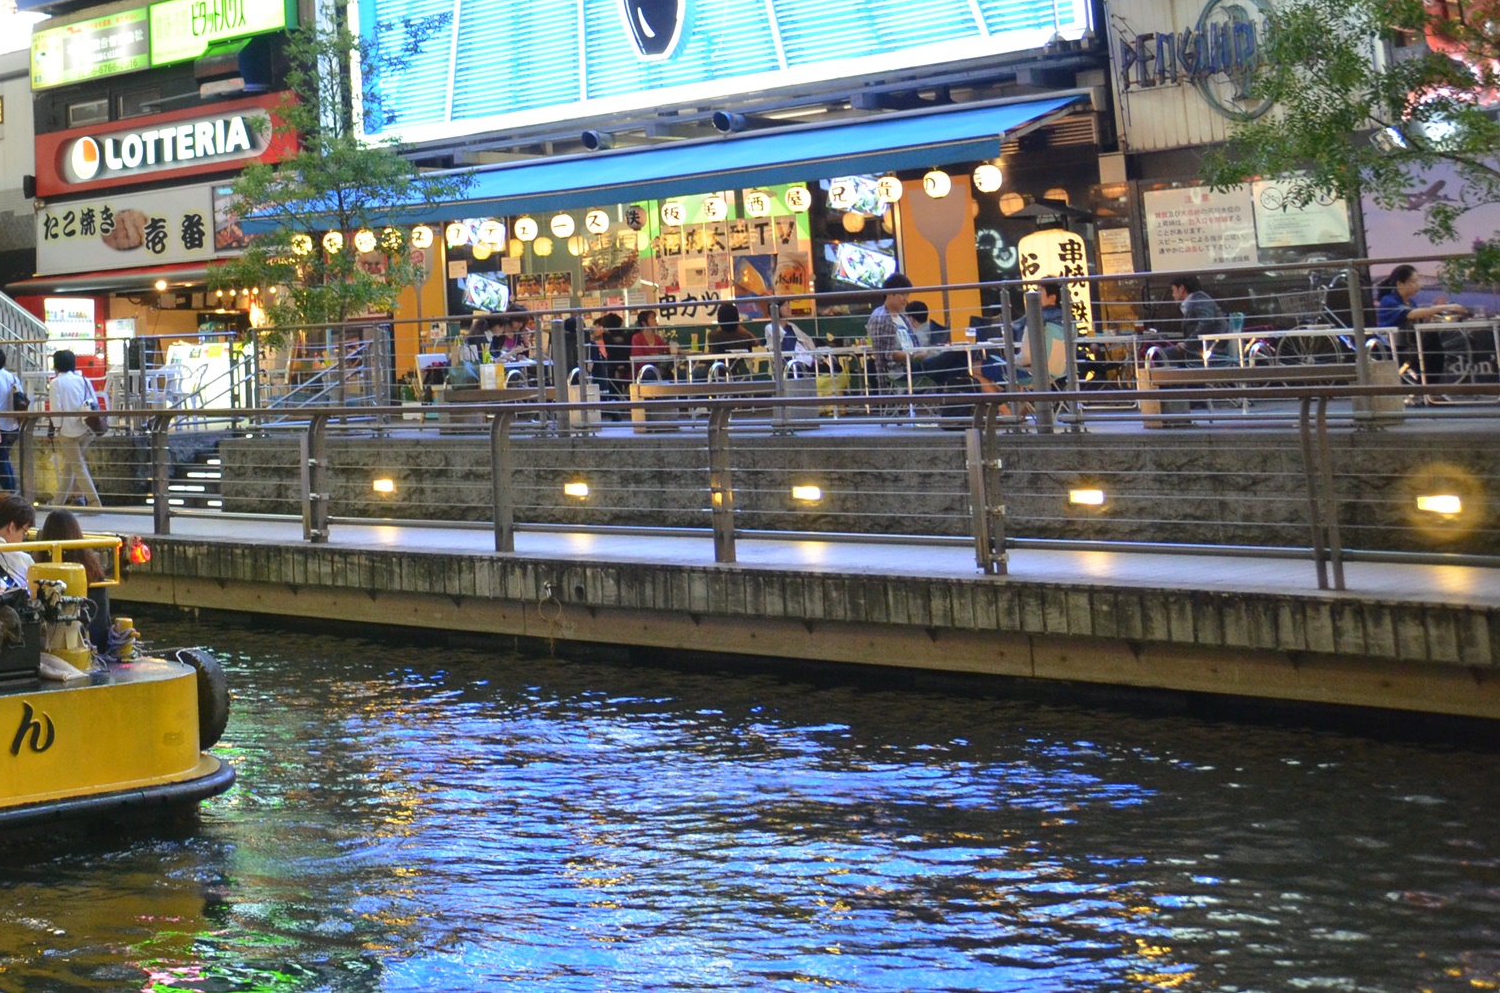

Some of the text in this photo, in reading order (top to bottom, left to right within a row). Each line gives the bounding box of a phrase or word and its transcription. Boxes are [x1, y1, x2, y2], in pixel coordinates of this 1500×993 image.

[104, 115, 252, 171] LOTTERIA
[43, 204, 117, 241] たこ焼き
